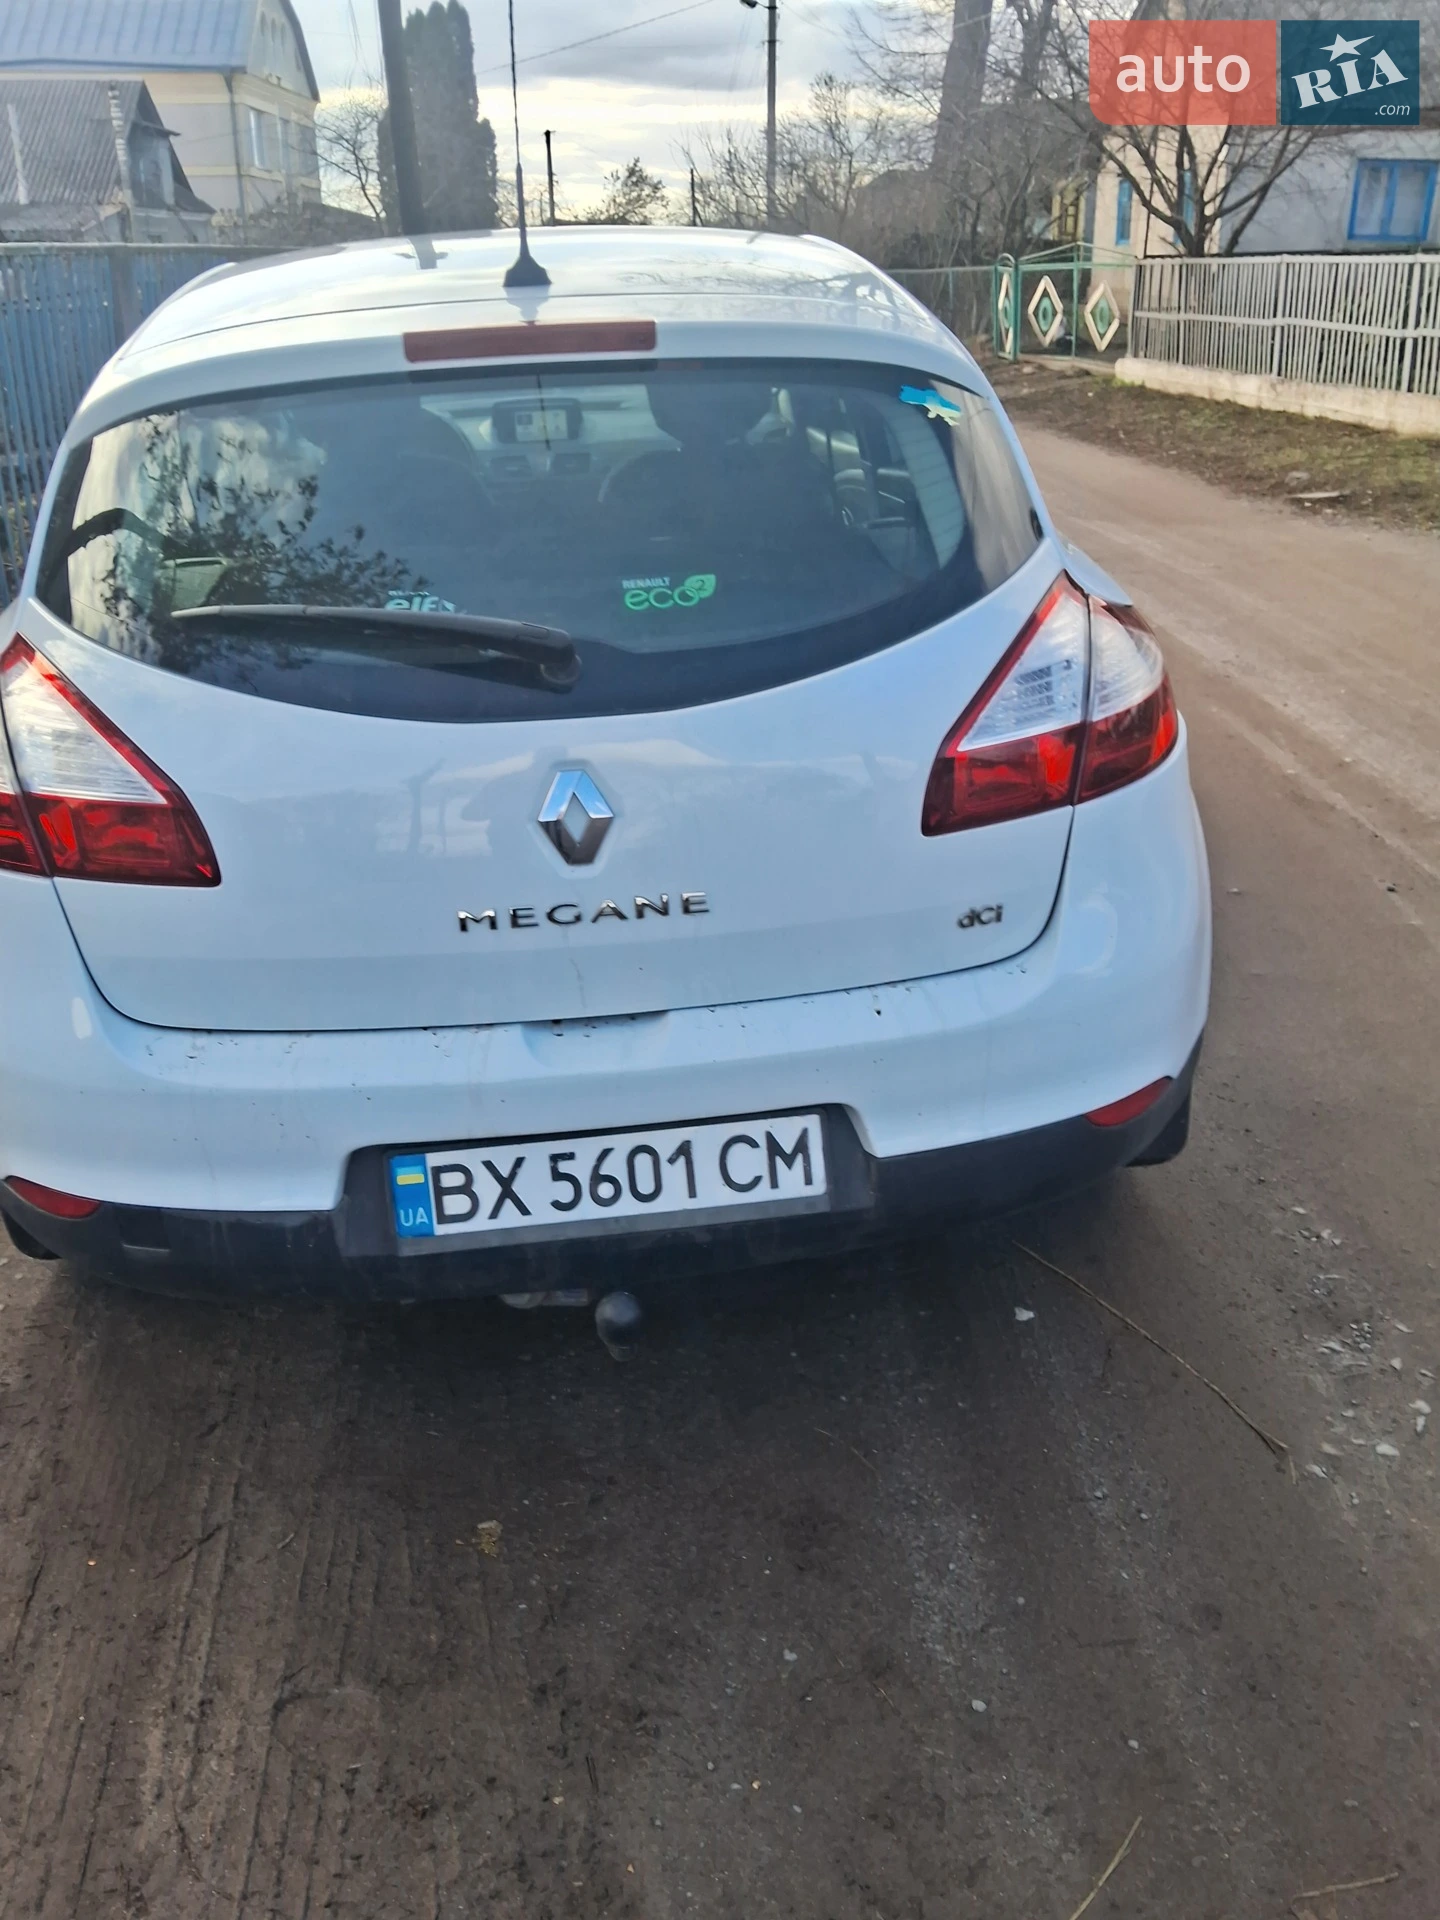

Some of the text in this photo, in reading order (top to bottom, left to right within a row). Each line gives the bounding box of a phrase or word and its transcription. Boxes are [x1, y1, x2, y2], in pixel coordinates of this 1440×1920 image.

[621, 577, 670, 589] RENAULT
[457, 892, 709, 932] MEGANE
[431, 1127, 813, 1225] BX 5601 CM
[400, 1207, 429, 1227] UA
